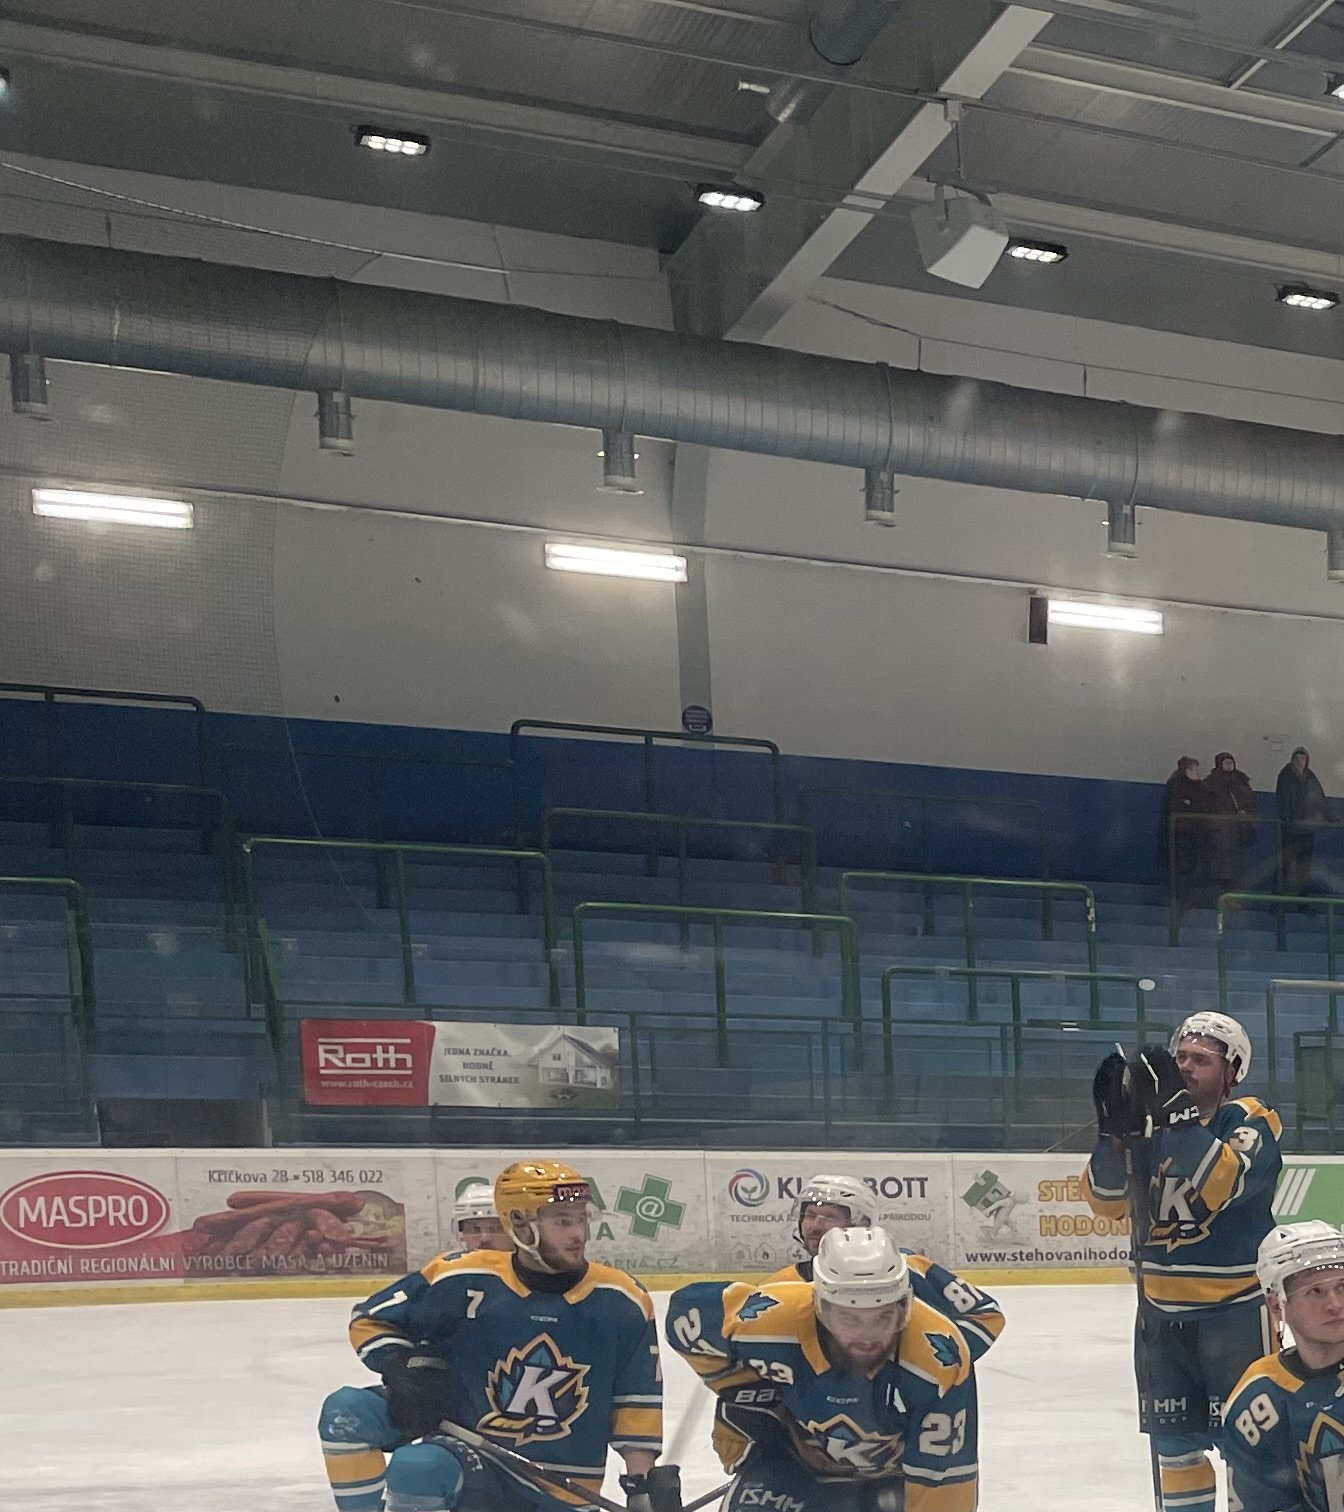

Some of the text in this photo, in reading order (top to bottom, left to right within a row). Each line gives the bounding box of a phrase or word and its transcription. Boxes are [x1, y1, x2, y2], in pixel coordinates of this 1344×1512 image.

[318, 1044, 413, 1068] Roth
[272, 1170, 288, 1183] 28
[302, 1170, 324, 1183] 518
[330, 1170, 353, 1183] 346
[360, 1170, 383, 1183] 022
[19, 1195, 149, 1228] MASPRO
[1, 1256, 72, 1277] TRADIČNÍ
[464, 1288, 485, 1319] 7
[506, 1365, 570, 1418] K
[1235, 1392, 1280, 1448] 89
